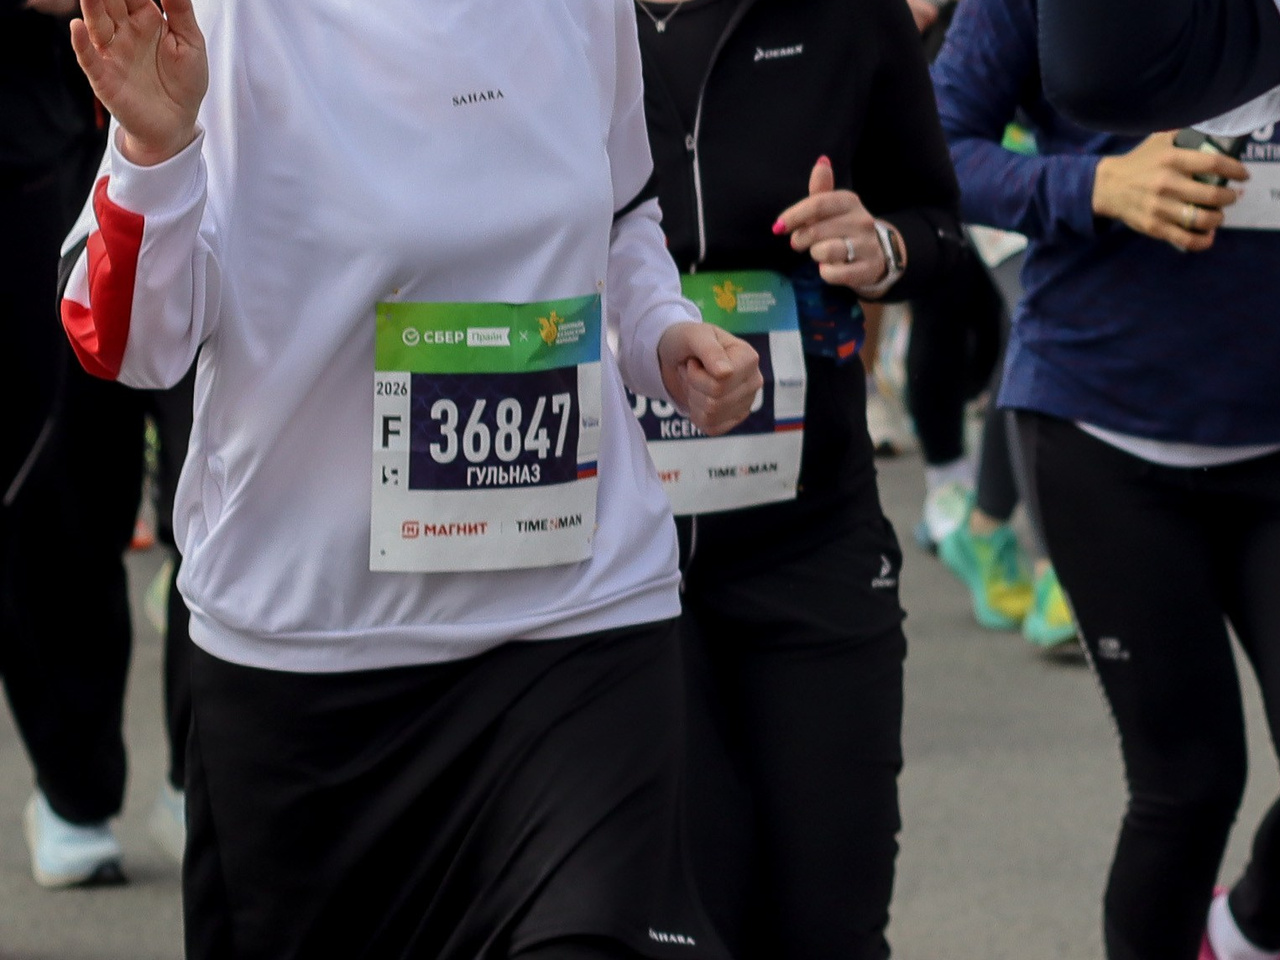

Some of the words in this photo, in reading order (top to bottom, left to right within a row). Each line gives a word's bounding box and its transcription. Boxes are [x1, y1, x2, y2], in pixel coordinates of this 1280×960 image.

[452, 89, 504, 106] SAHARA
[424, 330, 464, 344] СБЕР
[376, 381, 408, 396] 2026
[382, 415, 401, 448] F
[429, 393, 572, 465] 36847
[660, 418, 705, 438] КСЕН
[467, 463, 541, 486] ГУЛЬНАЗ
[424, 521, 488, 536] МАГНИТ
